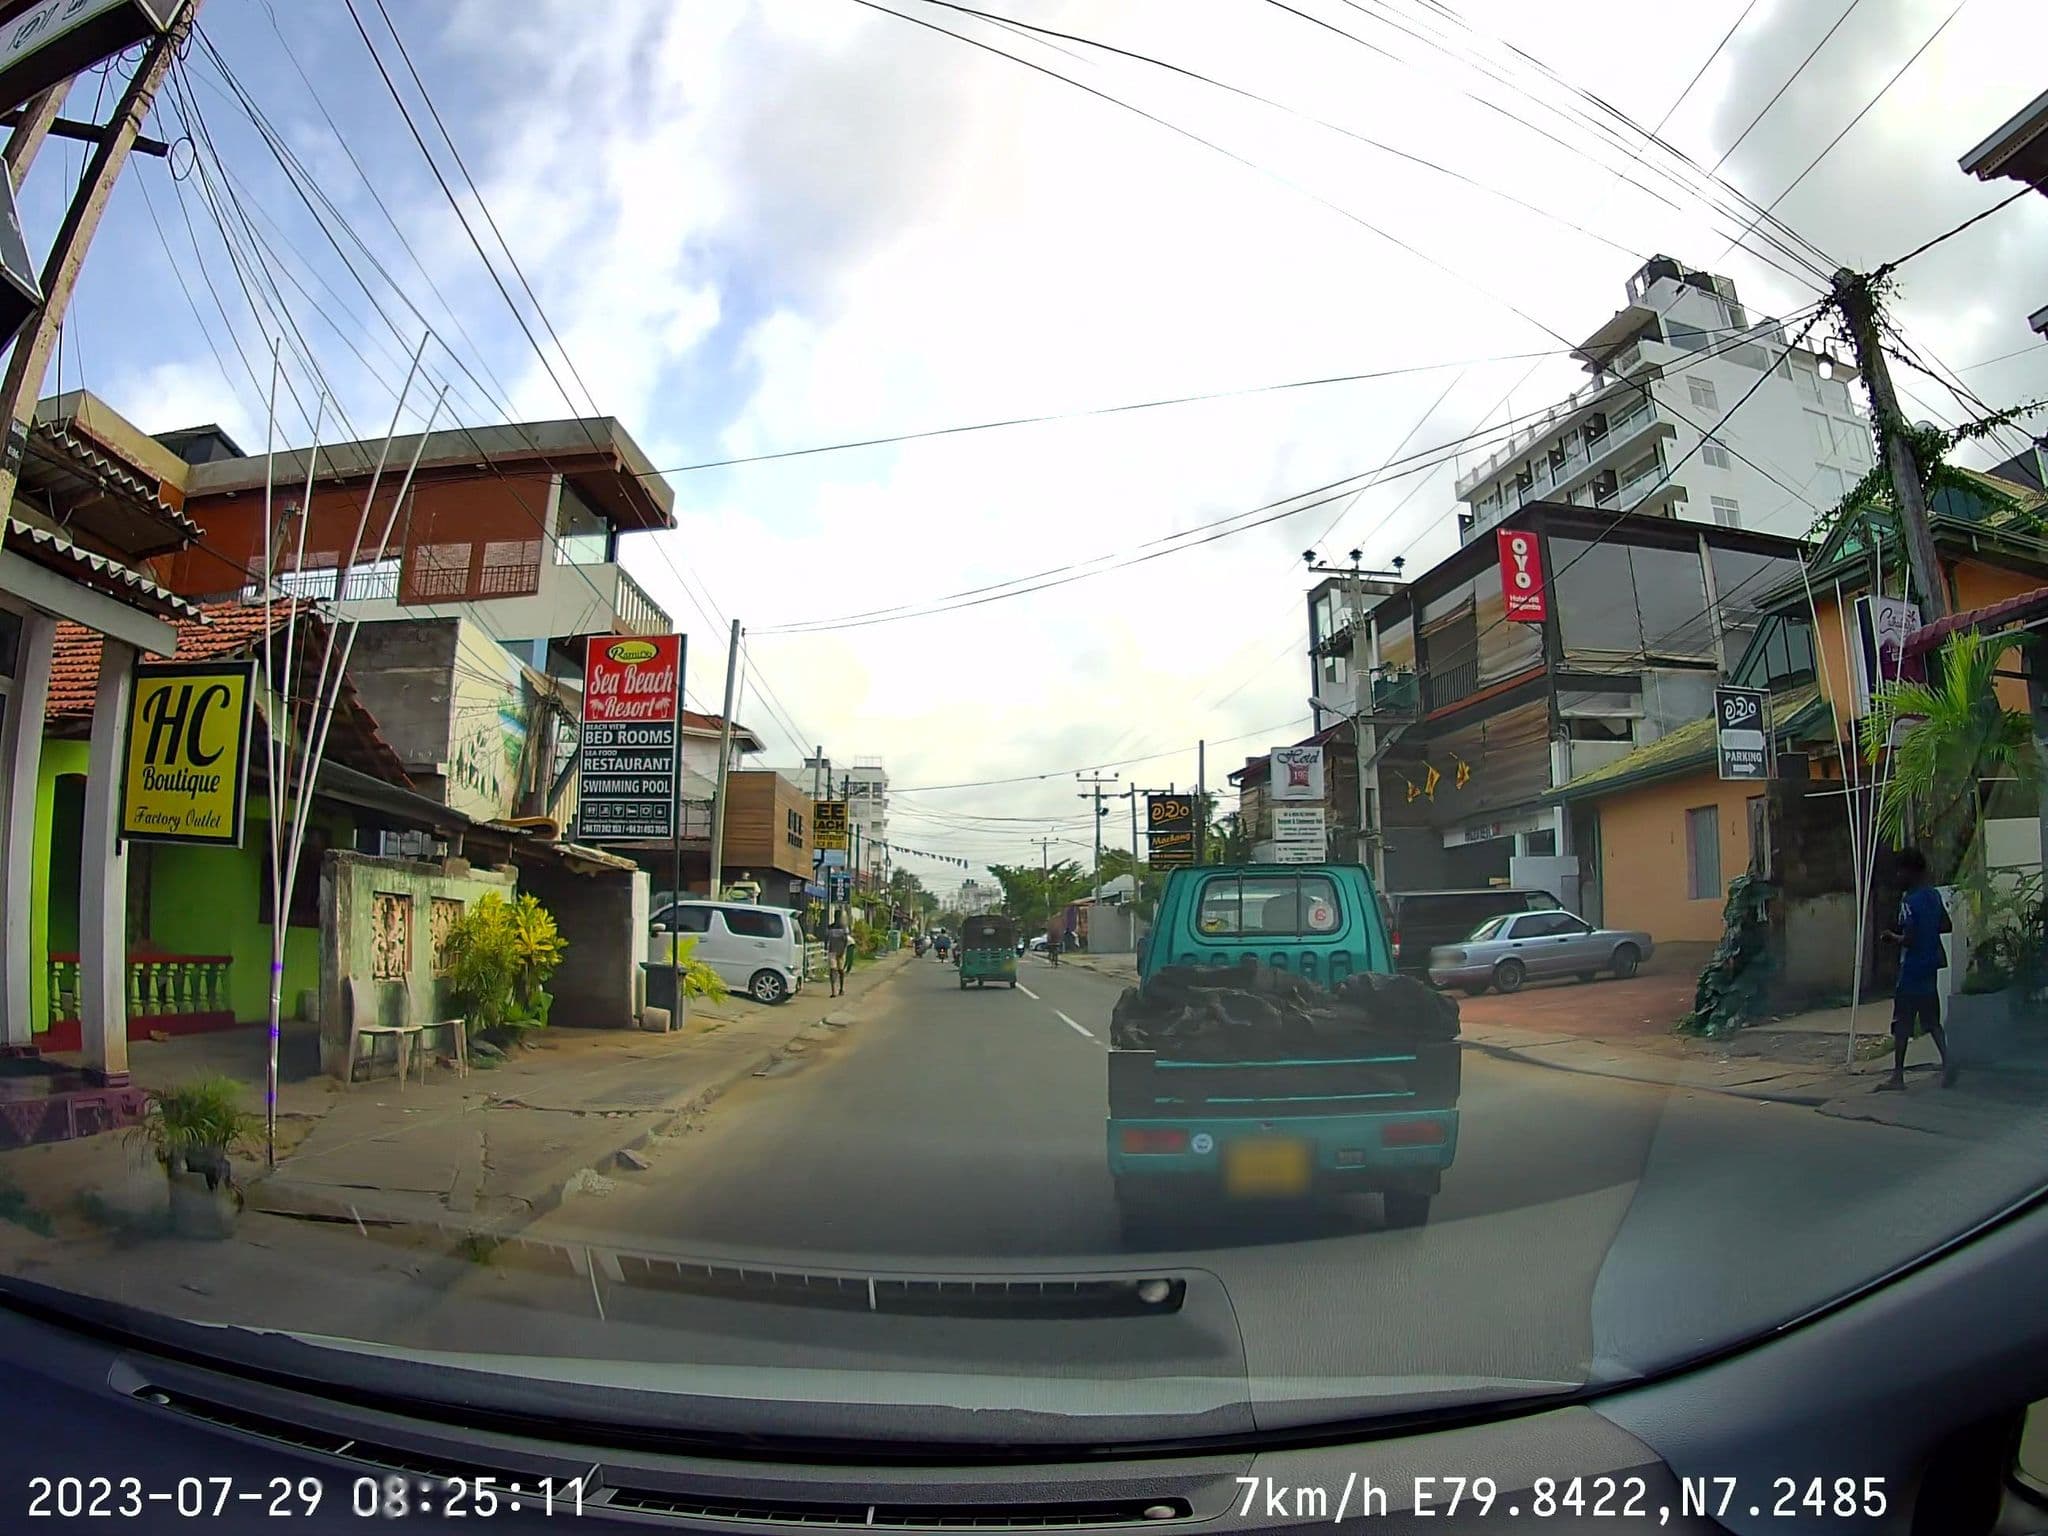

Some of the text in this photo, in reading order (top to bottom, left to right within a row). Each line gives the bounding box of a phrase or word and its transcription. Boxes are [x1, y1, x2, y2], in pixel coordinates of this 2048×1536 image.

[1511, 538, 1531, 589] OYO
[590, 664, 673, 695] Sea Beach
[604, 695, 656, 718] Resort
[142, 684, 231, 767] HC
[584, 730, 672, 745] BED ROOMS
[583, 758, 672, 771] RESTAURANT
[1725, 751, 1763, 764] PARKING
[143, 766, 221, 800] Boutique
[582, 780, 671, 794] SWIMMING POOL
[134, 806, 221, 832] Factory Outlet
